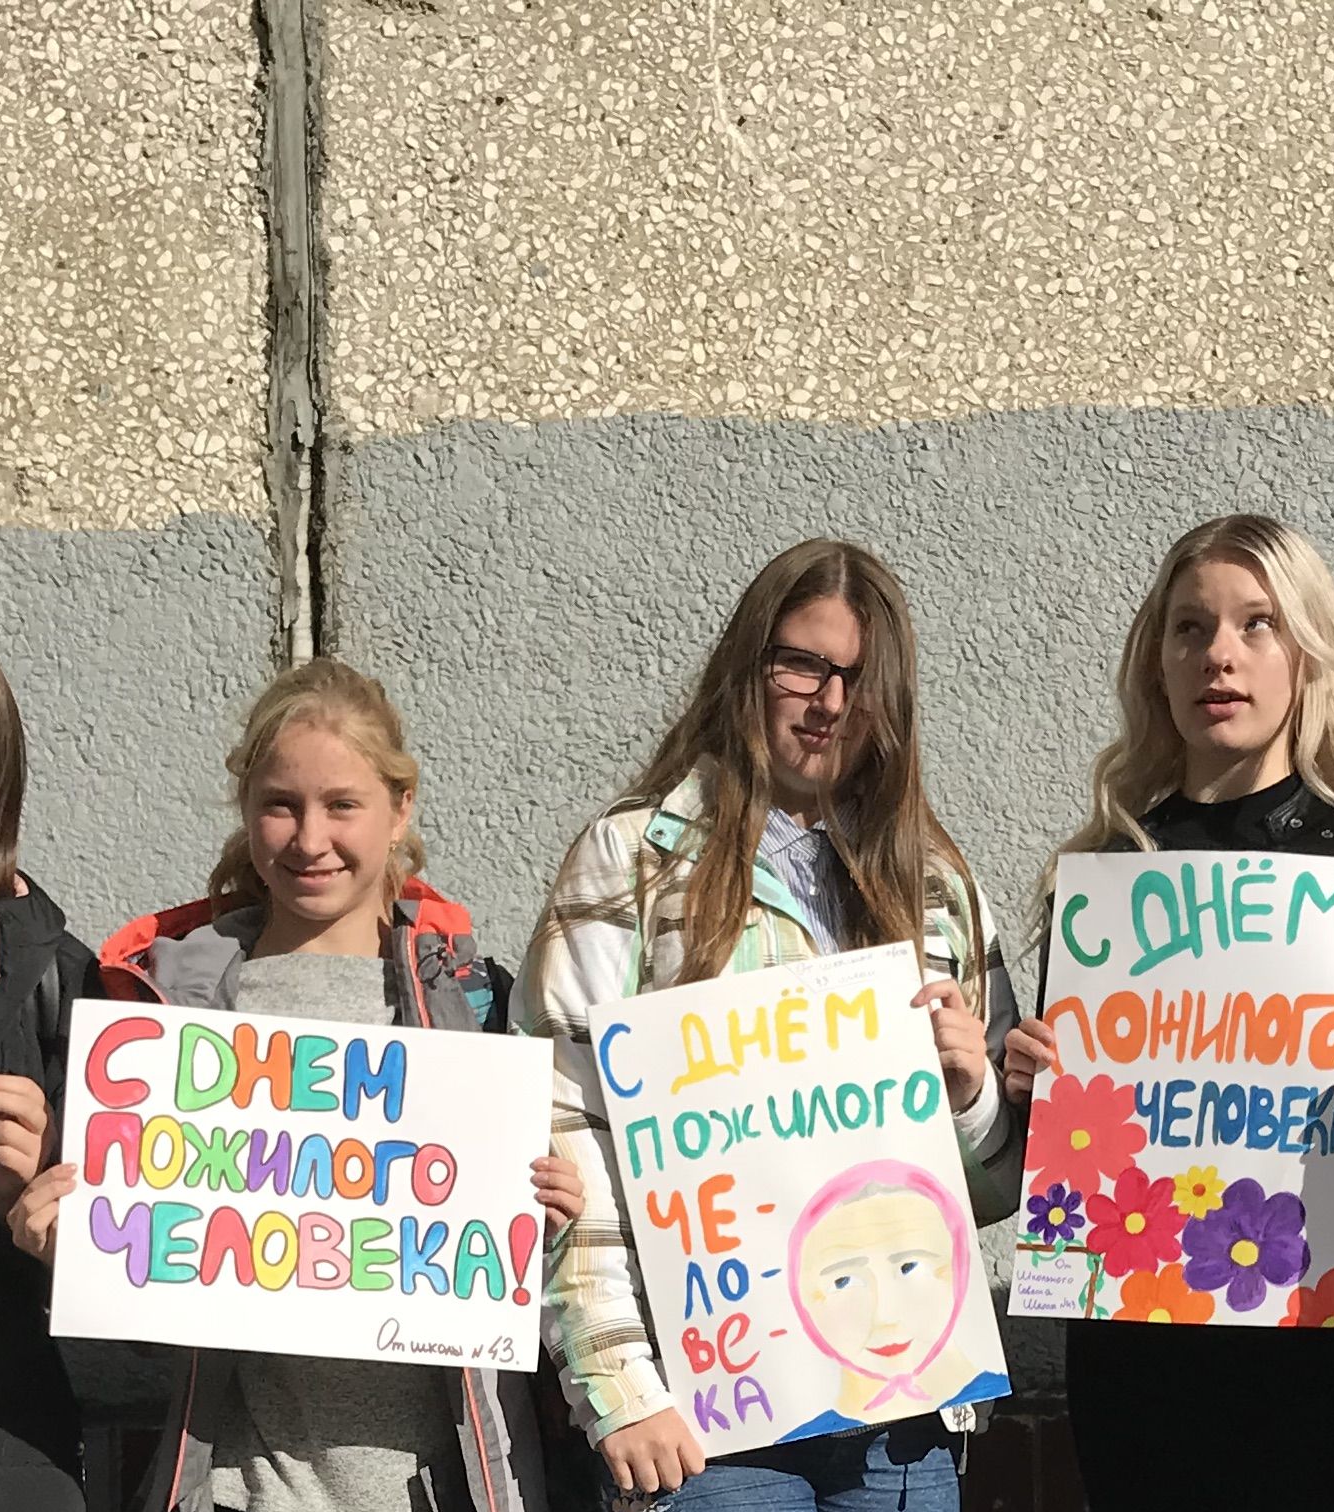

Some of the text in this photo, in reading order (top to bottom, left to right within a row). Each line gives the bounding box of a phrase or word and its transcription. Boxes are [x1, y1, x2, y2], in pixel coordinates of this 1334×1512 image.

[1061, 893, 1111, 968] С
[84, 1016, 164, 1109] С
[598, 987, 879, 1098] С ДНЁМ
[84, 1111, 457, 1206] ПОЖИЛОГО
[625, 1069, 941, 1178] ПОЖИЛОГО
[89, 1195, 538, 1306] ЧЕЛОВЕКА!
